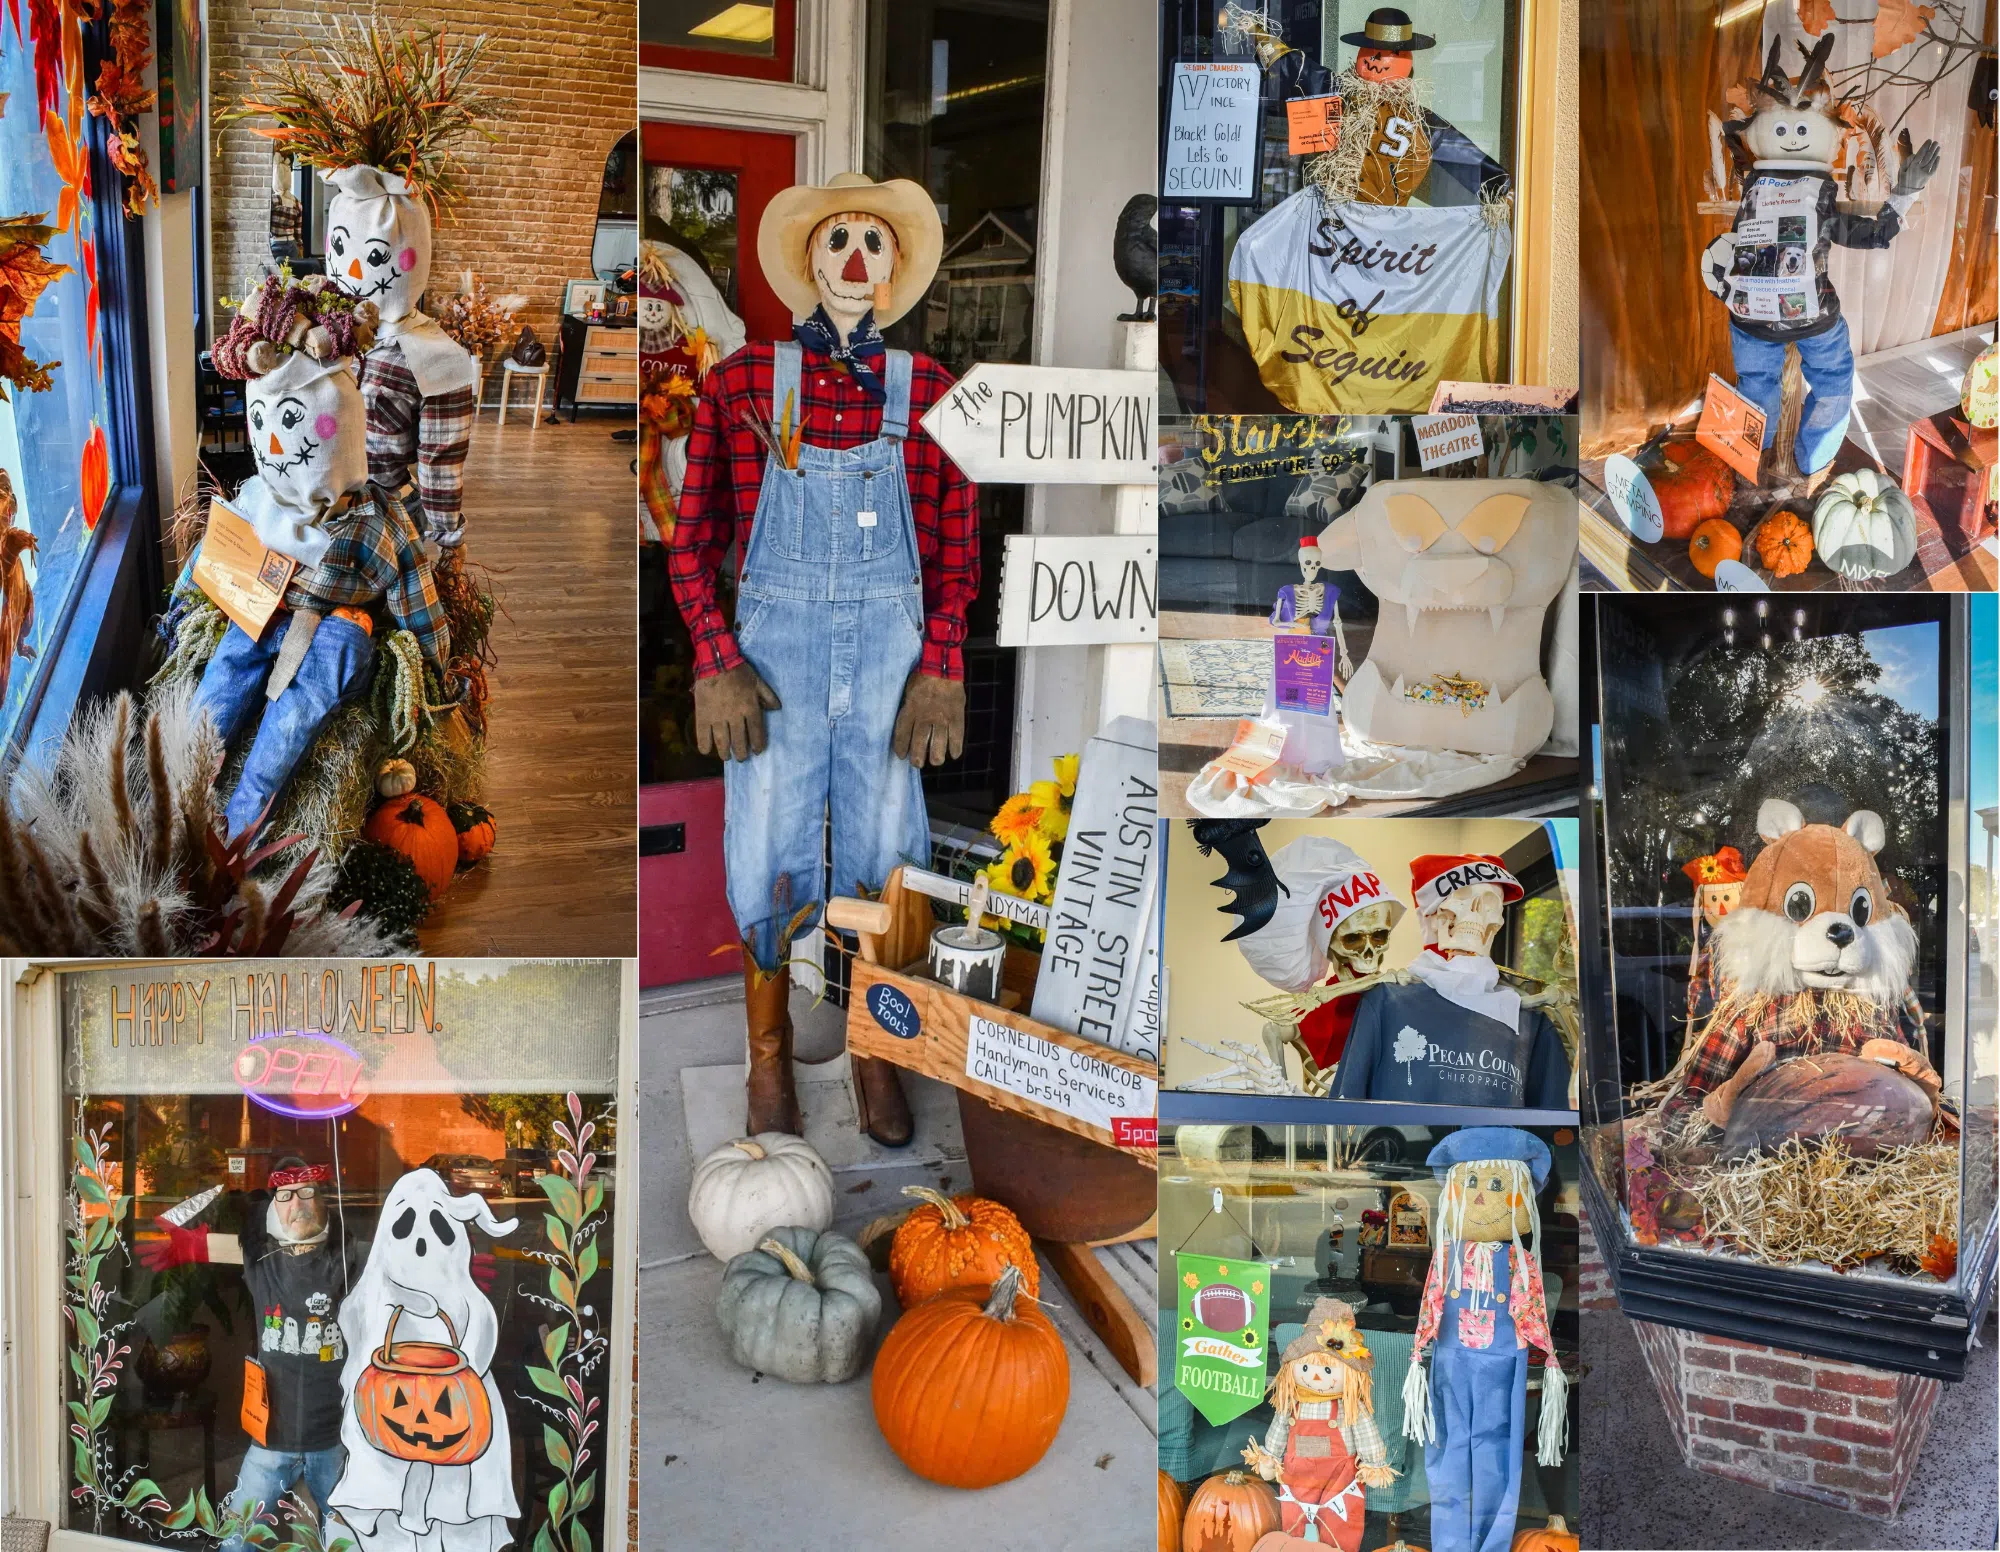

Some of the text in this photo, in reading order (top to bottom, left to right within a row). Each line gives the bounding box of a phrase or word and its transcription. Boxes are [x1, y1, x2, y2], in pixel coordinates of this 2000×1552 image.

[1174, 123, 1242, 142] Black! Gold!
[1215, 147, 1228, 163] Go
[1378, 115, 1414, 157] S
[1168, 166, 1242, 191] SEGUIN!
[1309, 217, 1438, 276] Spirit
[1336, 289, 1386, 338] of
[1281, 324, 1429, 387] Seguin
[951, 380, 993, 426] the
[1000, 390, 1151, 461] PUMPKIN
[1417, 415, 1477, 441] MATADOR
[1422, 433, 1480, 461] THEATRE
[1219, 457, 1316, 480] FURNITURE
[1615, 472, 1650, 507] METAL
[1608, 481, 1662, 528] STAMPING
[1030, 560, 1157, 622] DOWN
[1050, 830, 1107, 979] VINTAGE
[1077, 775, 1157, 1042] AUSTIN STREE
[111, 980, 210, 1048] HAPPY
[878, 987, 911, 1018] Boo!
[234, 1045, 364, 1101] OPEN
[975, 1039, 1126, 1109] Handyman Services
[976, 1018, 1143, 1091] CORNELIUS CORNCOB
[1428, 1043, 1475, 1067] PECAN
[974, 1060, 1012, 1086] CALL
[1026, 1078, 1072, 1108] br549
[1120, 1121, 1158, 1146] Spo
[1194, 1340, 1249, 1364] Gather
[1180, 1364, 1260, 1399] FOOTBALL
